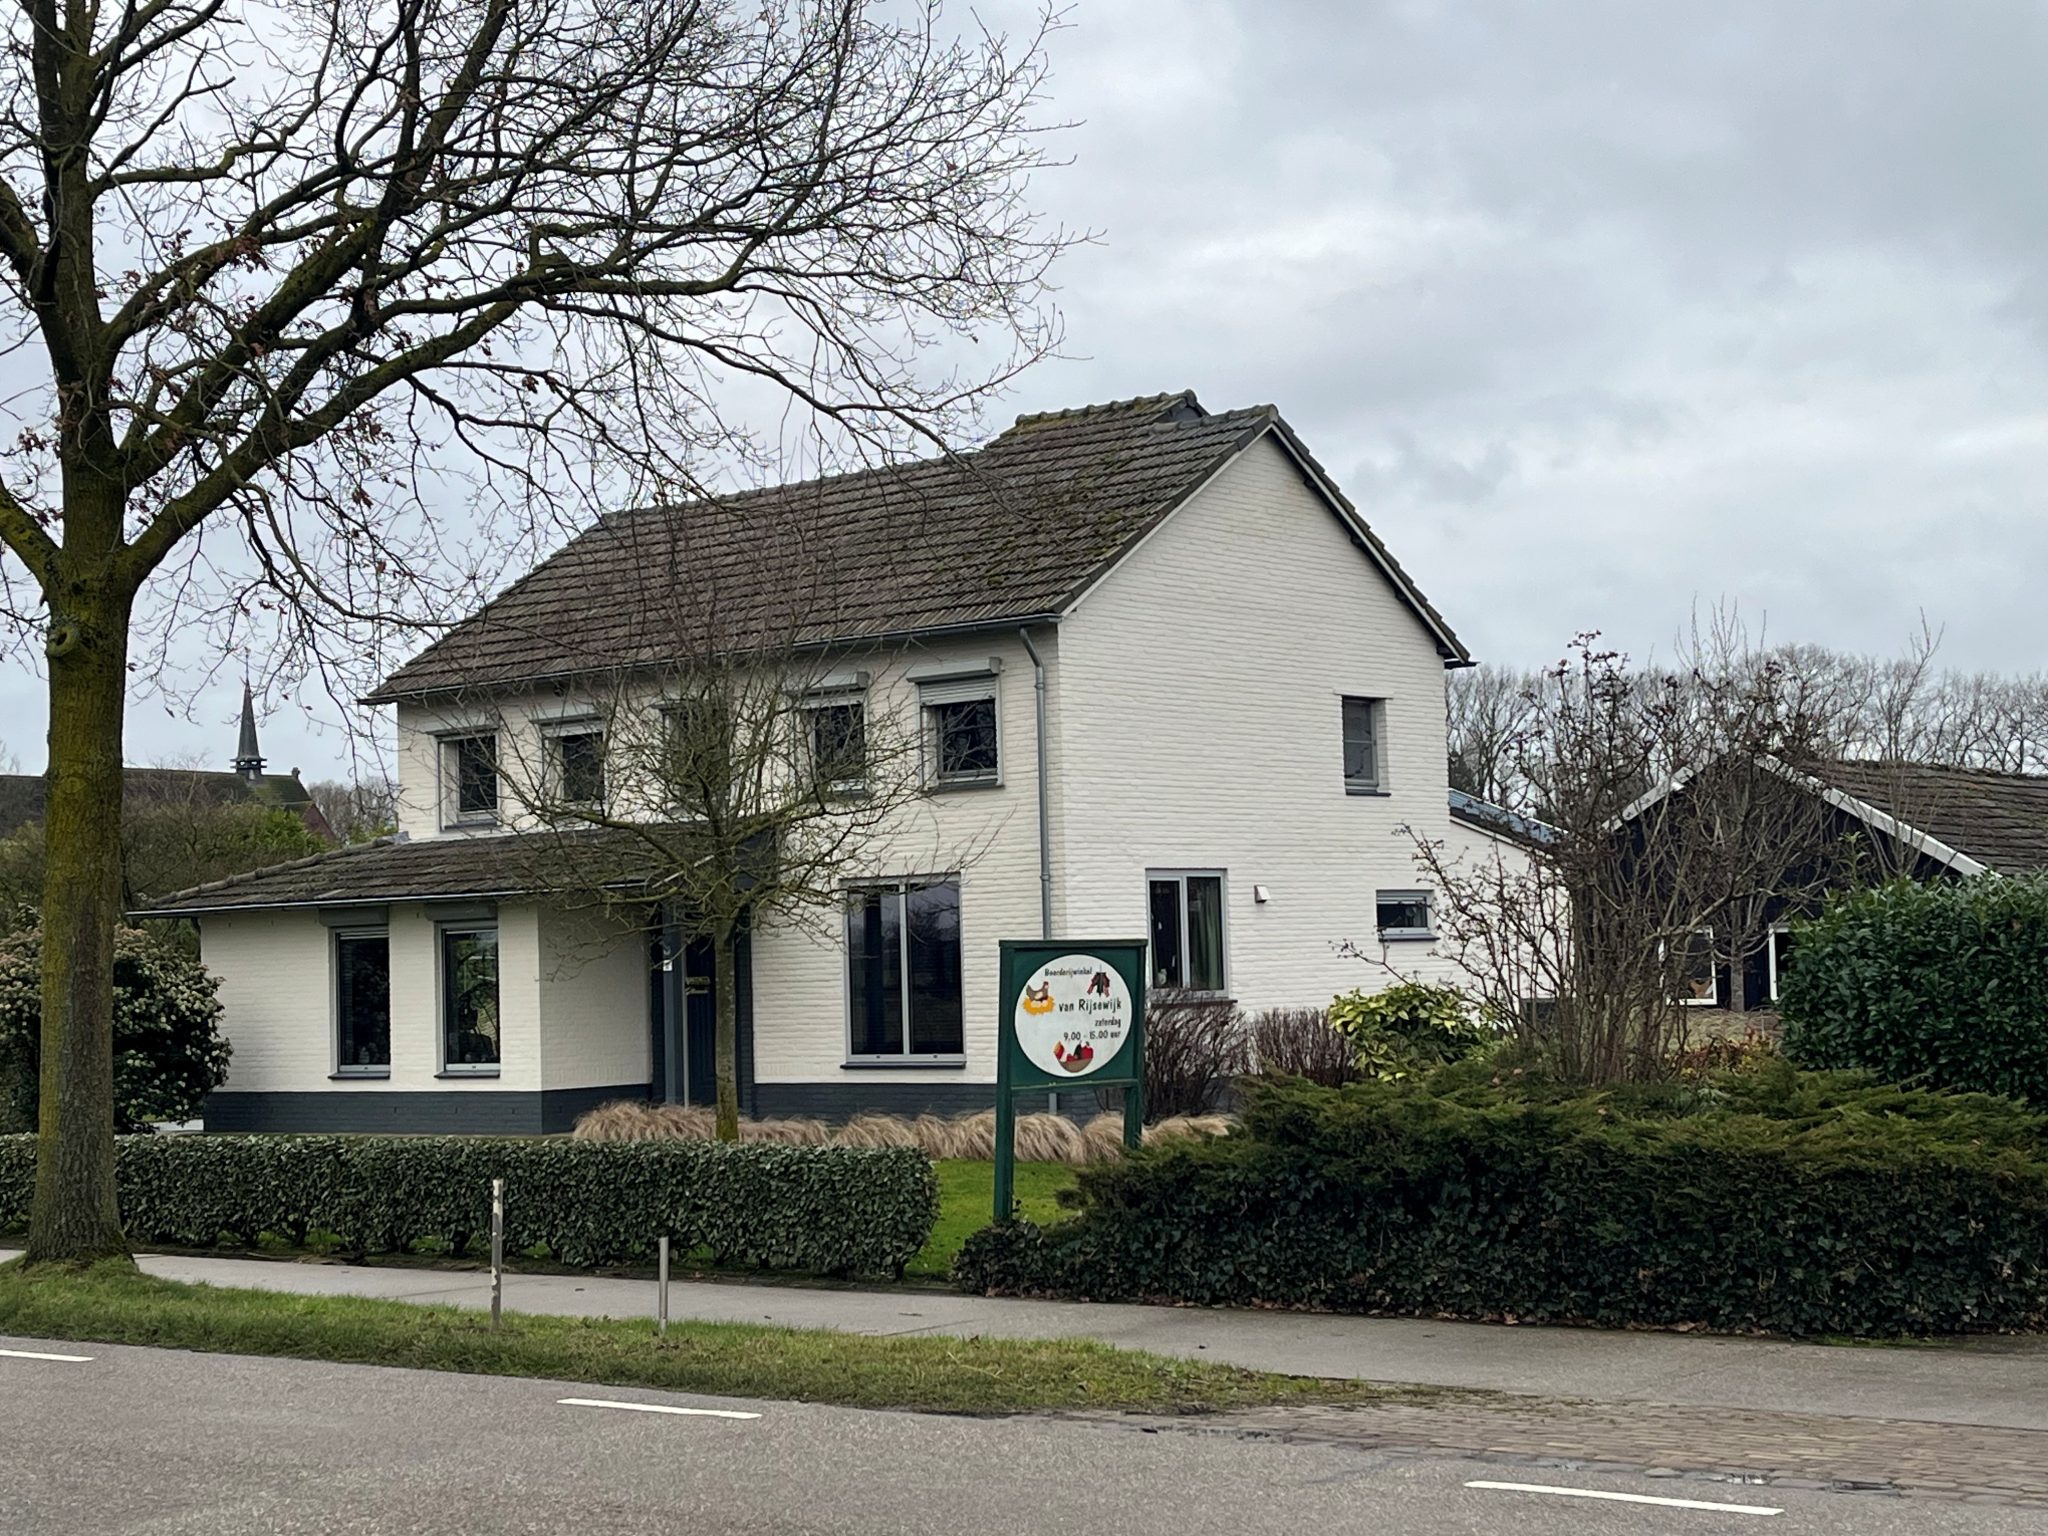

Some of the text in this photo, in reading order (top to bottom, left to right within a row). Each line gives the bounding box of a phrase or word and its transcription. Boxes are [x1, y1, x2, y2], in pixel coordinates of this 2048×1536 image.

[1044, 967, 1093, 978] Boerderijwinkel
[1059, 1002, 1074, 1012] van
[1095, 1016, 1121, 1028] zaterdag
[1063, 1031, 1081, 1041] 9.00
[1089, 1030, 1108, 1040] 15.00
[1110, 1031, 1121, 1039] uur
